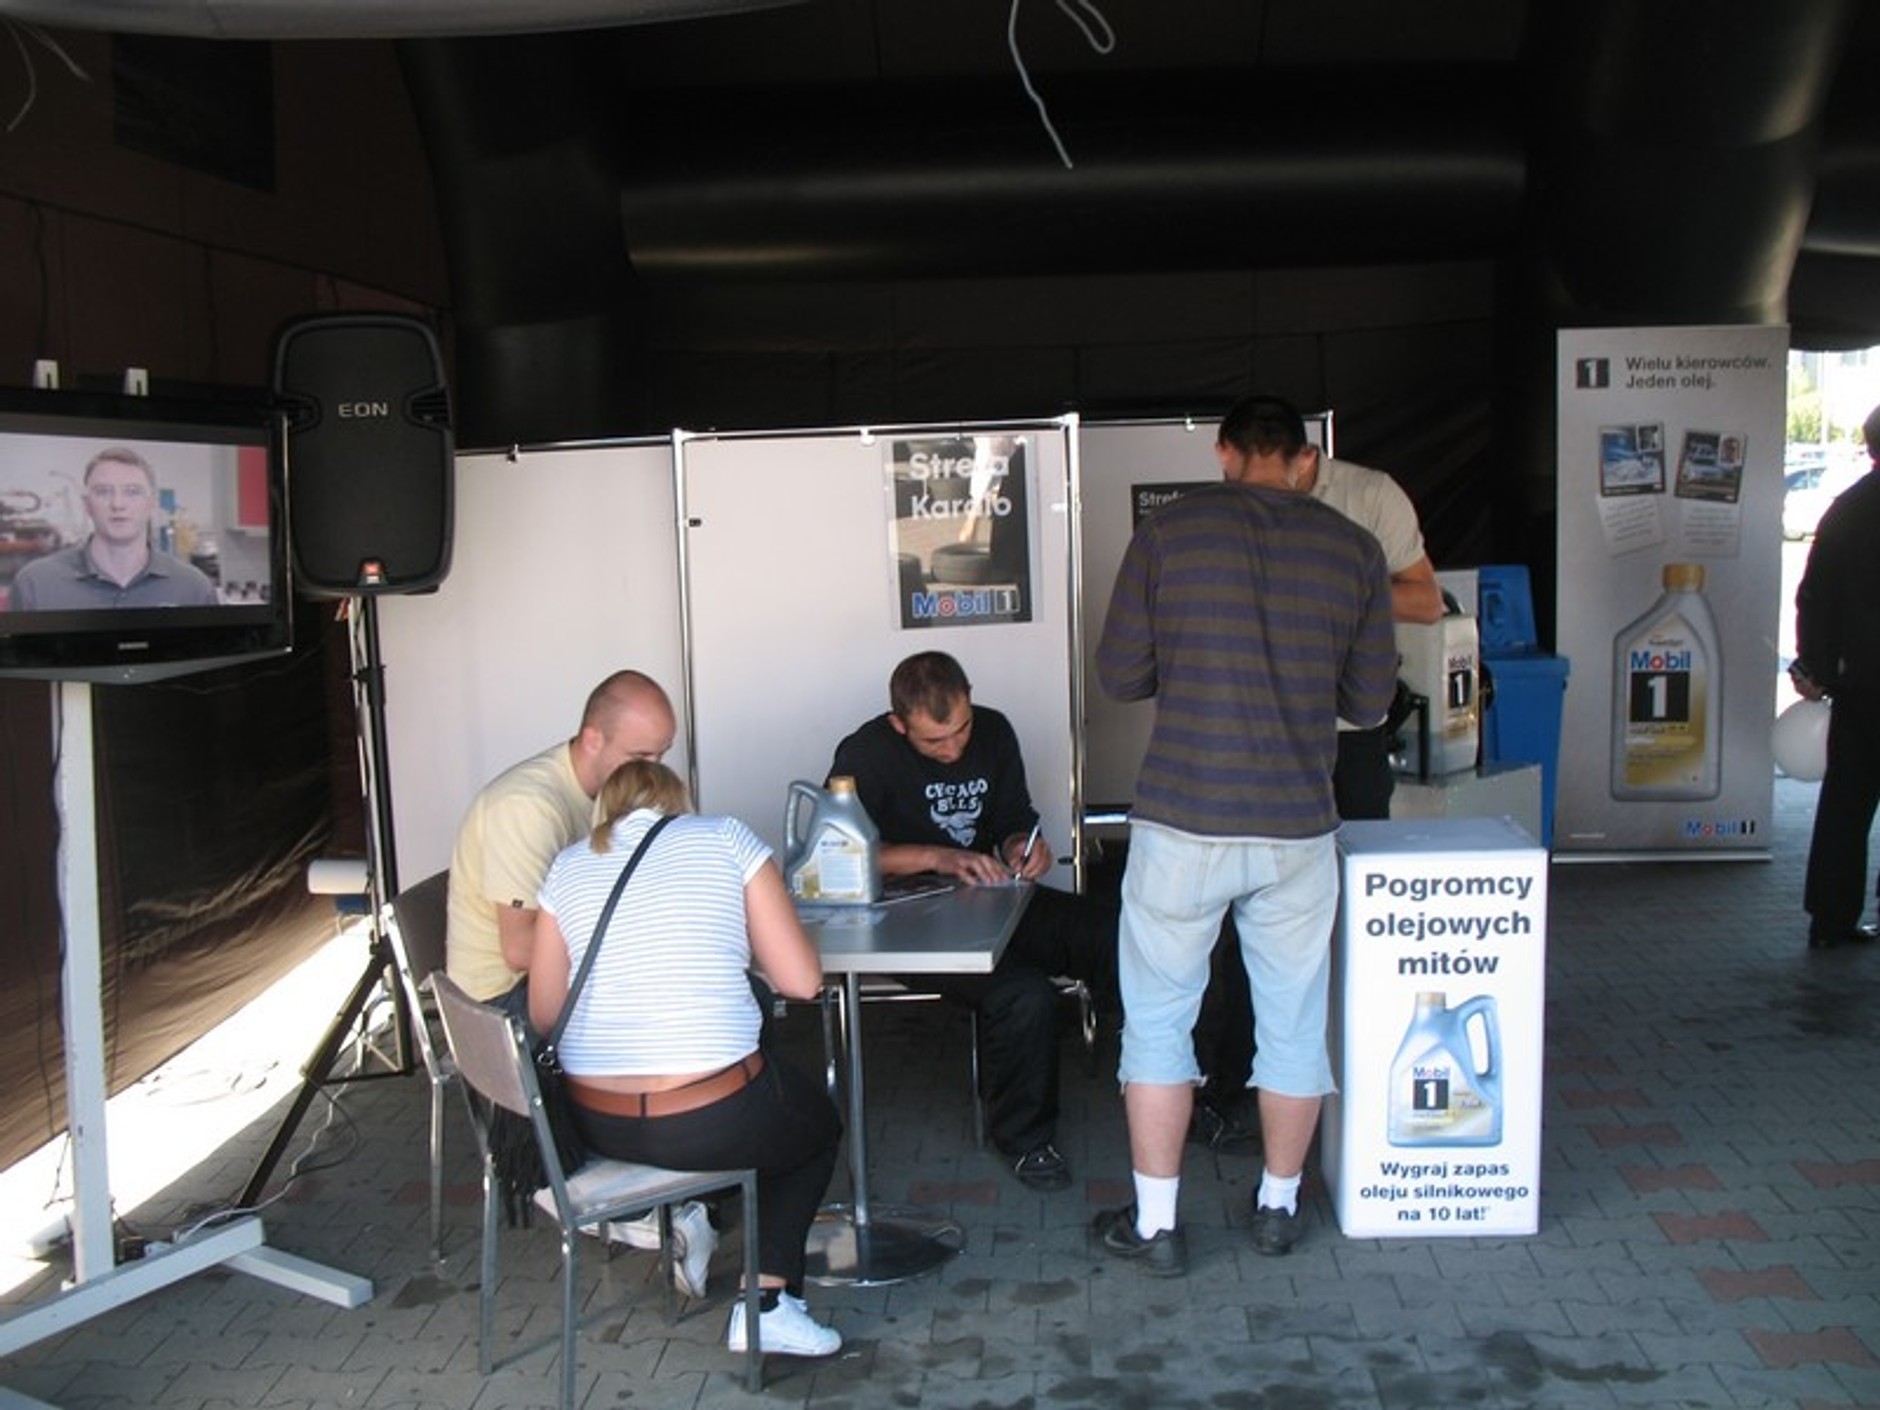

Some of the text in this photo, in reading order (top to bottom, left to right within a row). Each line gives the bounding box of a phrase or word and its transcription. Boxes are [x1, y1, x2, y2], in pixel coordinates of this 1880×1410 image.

[1625, 355, 1771, 371] Wielu kierowców.
[1625, 372, 1717, 390] Jeden olej.
[338, 402, 388, 418] EON
[909, 452, 1010, 480] Strea
[1139, 490, 1185, 507] Stref
[912, 587, 990, 619] Mobil
[1630, 650, 1692, 670] Mobil
[925, 778, 988, 799] CCAGO
[1686, 820, 1737, 837] Mobil
[1364, 872, 1534, 902] Pogromcy
[1365, 909, 1532, 942] olejowych
[1397, 948, 1500, 975] mitów
[1412, 1066, 1451, 1079] Mobil
[1380, 1161, 1511, 1179] Wygraj zapas
[1359, 1183, 1530, 1201] oleju silnikowego
[1397, 1208, 1421, 1221] na
[1429, 1206, 1451, 1221] 10
